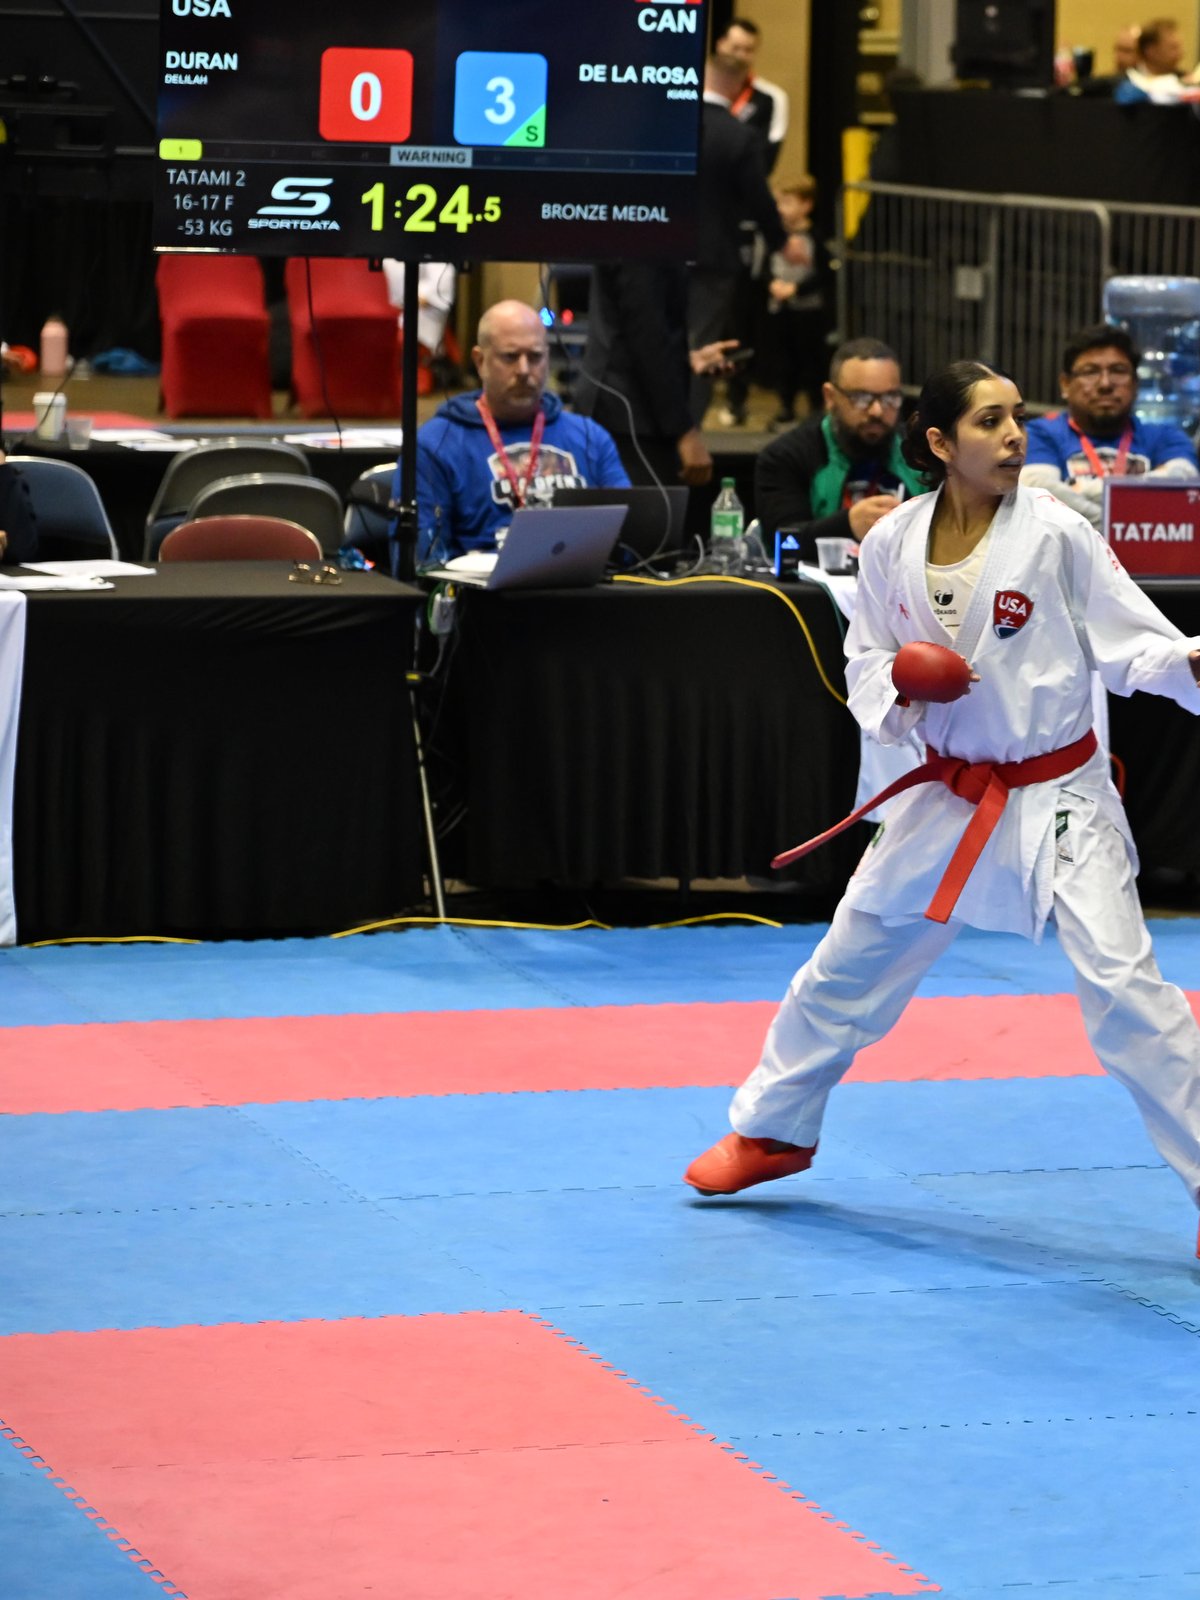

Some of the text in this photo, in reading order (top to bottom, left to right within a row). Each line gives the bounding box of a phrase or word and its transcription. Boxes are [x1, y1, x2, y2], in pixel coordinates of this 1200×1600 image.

[171, 0, 232, 18] USA
[637, 8, 698, 34] CAN
[165, 51, 238, 71] DURAN
[164, 74, 209, 85] DELILAH
[579, 63, 699, 86] DE LA ROSA
[349, 72, 383, 122] 0
[483, 76, 517, 126] 3
[525, 125, 540, 142] S
[397, 151, 467, 164] WARNING
[166, 169, 247, 187] TATAMI 2
[173, 194, 235, 211] 16-17 F
[541, 203, 670, 223] BRONZE MEDAL
[177, 218, 233, 237] -53 KG
[247, 218, 341, 232] SPORTDATA
[1112, 522, 1195, 542] TATAMI
[998, 595, 1028, 617] USA
